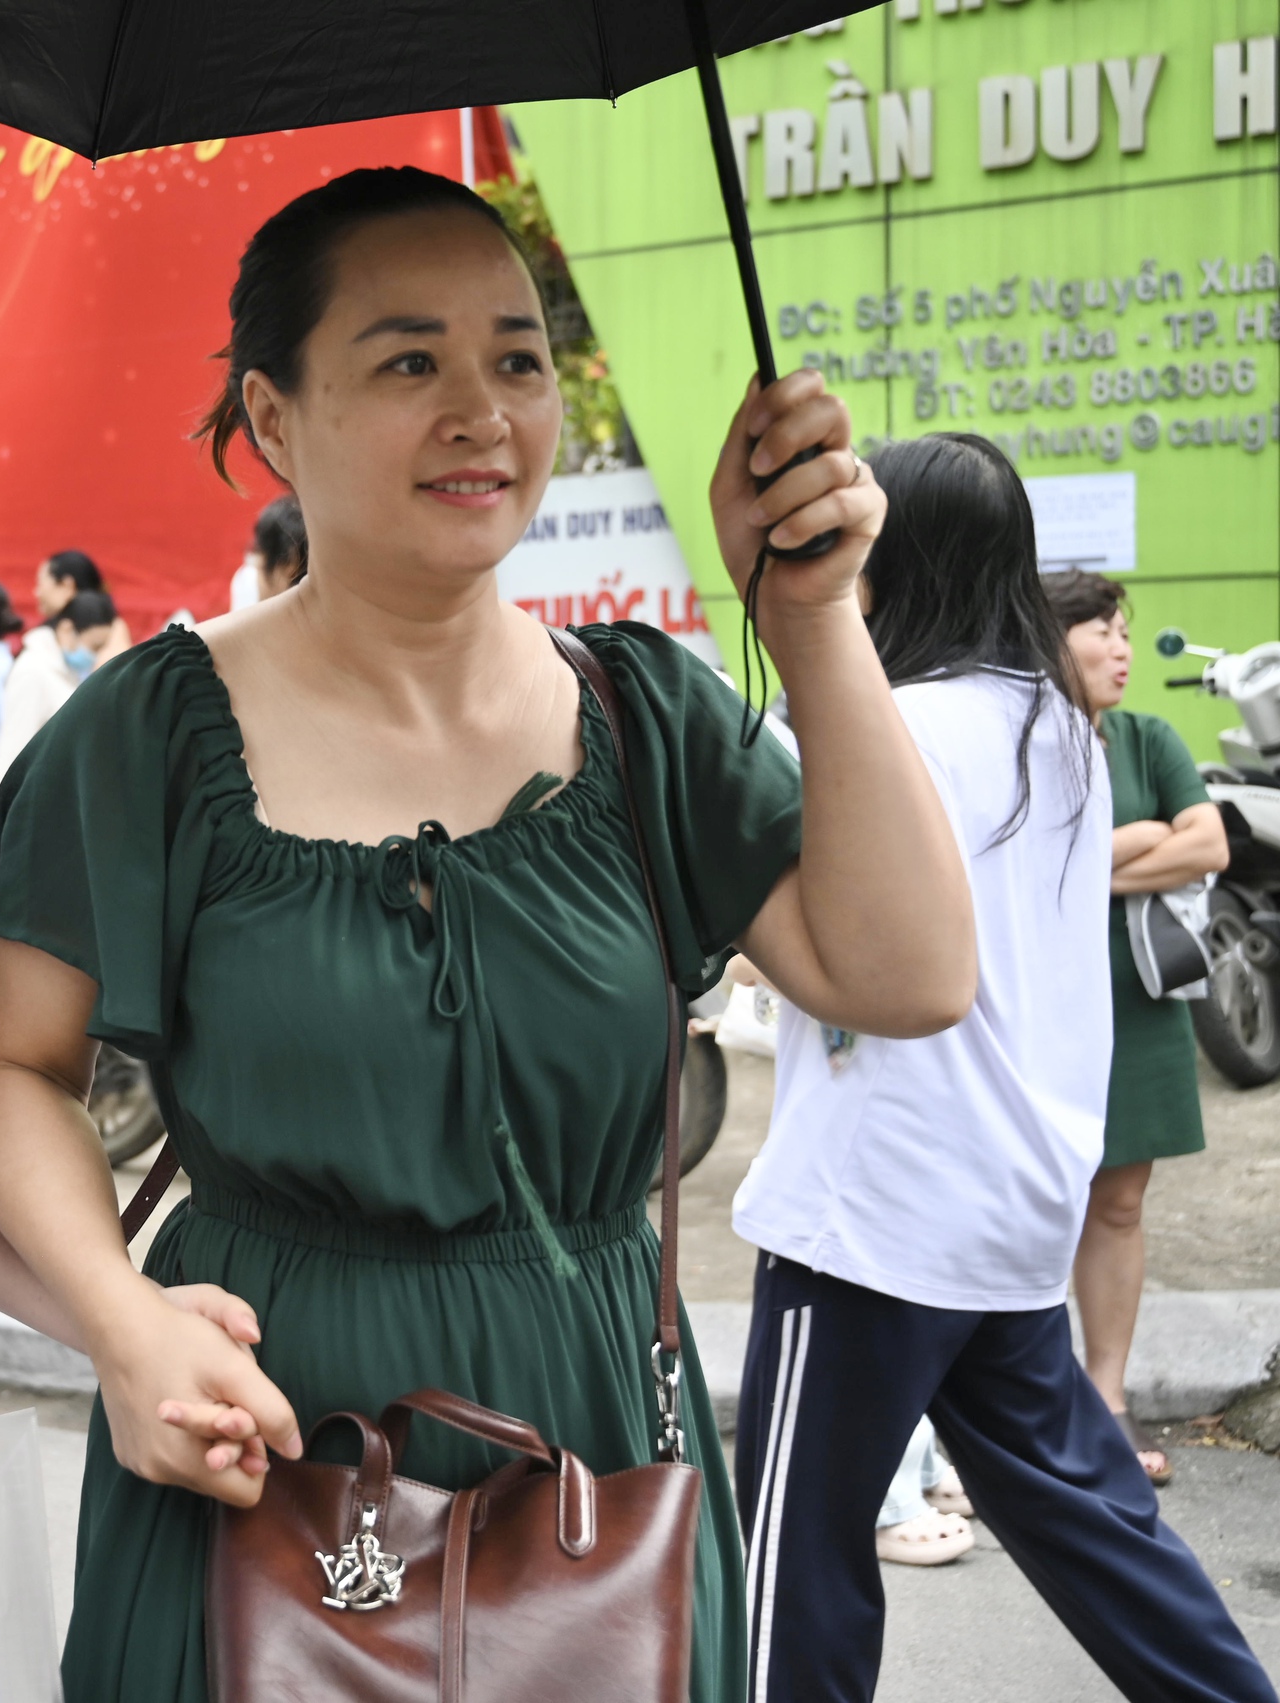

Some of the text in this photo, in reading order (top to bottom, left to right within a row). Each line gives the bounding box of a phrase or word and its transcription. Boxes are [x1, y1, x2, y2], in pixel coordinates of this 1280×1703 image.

[979, 53, 1164, 171] DUY
[855, 282, 905, 331] Số
[946, 274, 1020, 330] phố
[1029, 258, 1184, 320] Nguyễn
[957, 331, 1026, 373] Yên
[1041, 321, 1117, 364] Hòa
[1163, 309, 1224, 352] TP.
[989, 372, 1077, 414] 0243
[1090, 356, 1257, 407] 8803866
[567, 509, 613, 540] DUY
